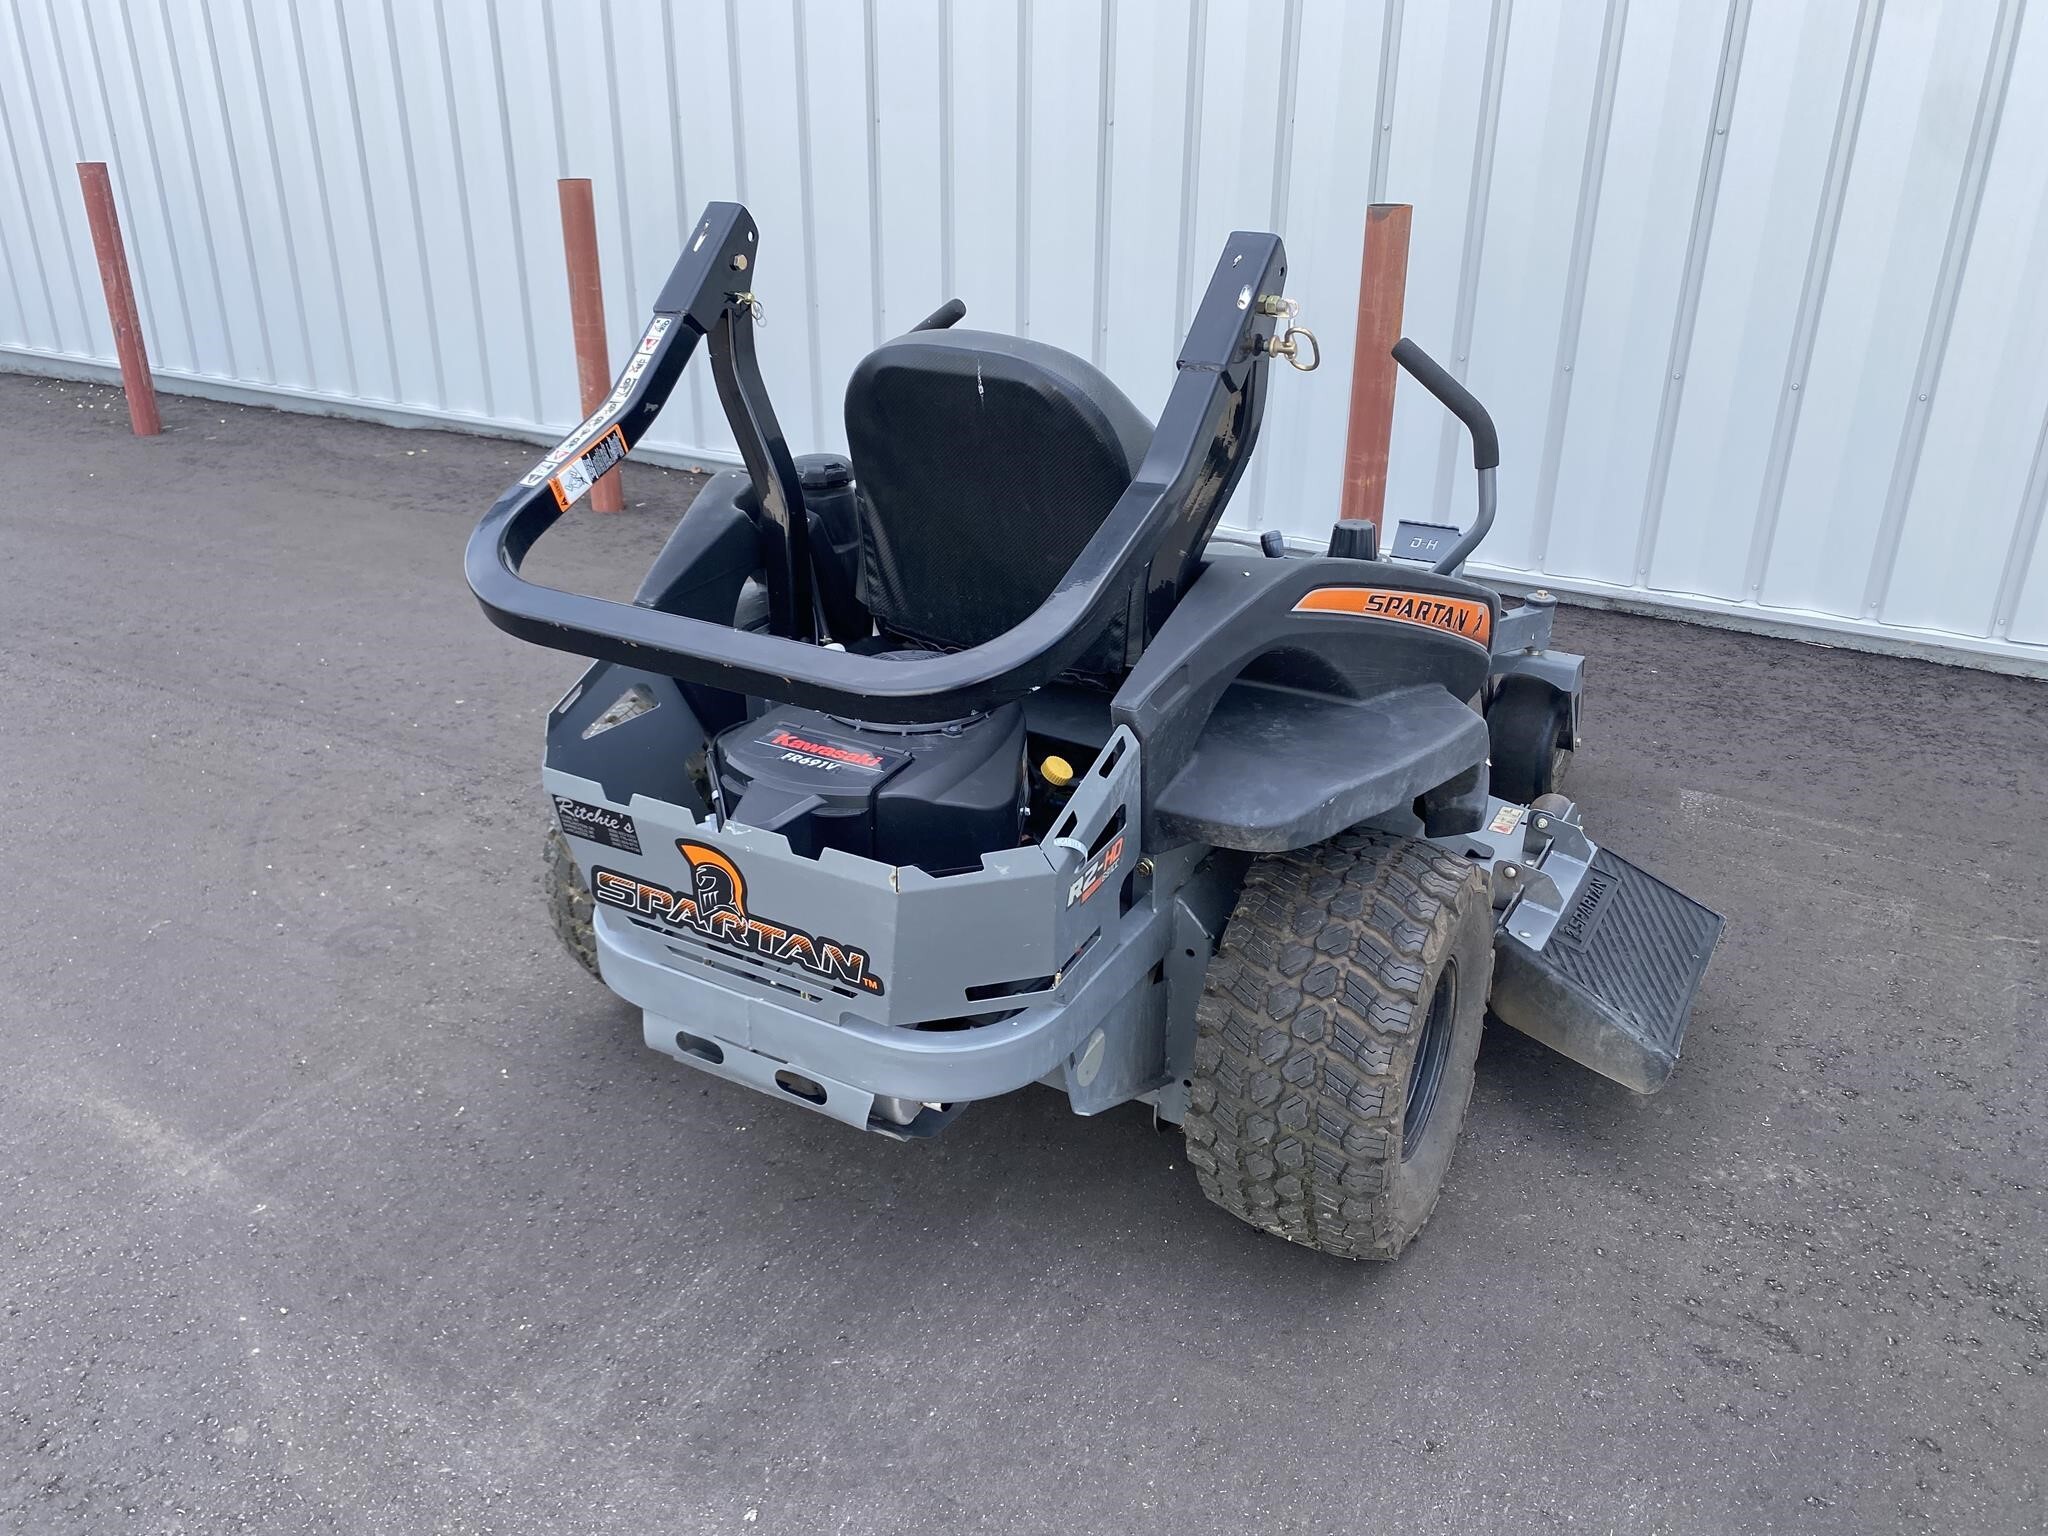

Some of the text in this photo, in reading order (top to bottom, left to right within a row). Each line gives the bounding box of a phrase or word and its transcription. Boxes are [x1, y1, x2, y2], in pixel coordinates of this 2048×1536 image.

[1364, 594, 1469, 632] SPARTAN
[771, 730, 884, 767] Kawasaki
[781, 752, 842, 771] FR691V
[555, 796, 635, 834] Ritchie's
[1066, 837, 1124, 909] RZ-HD
[1568, 877, 1607, 932] SPARTAN
[597, 871, 864, 983] SPARTAN
